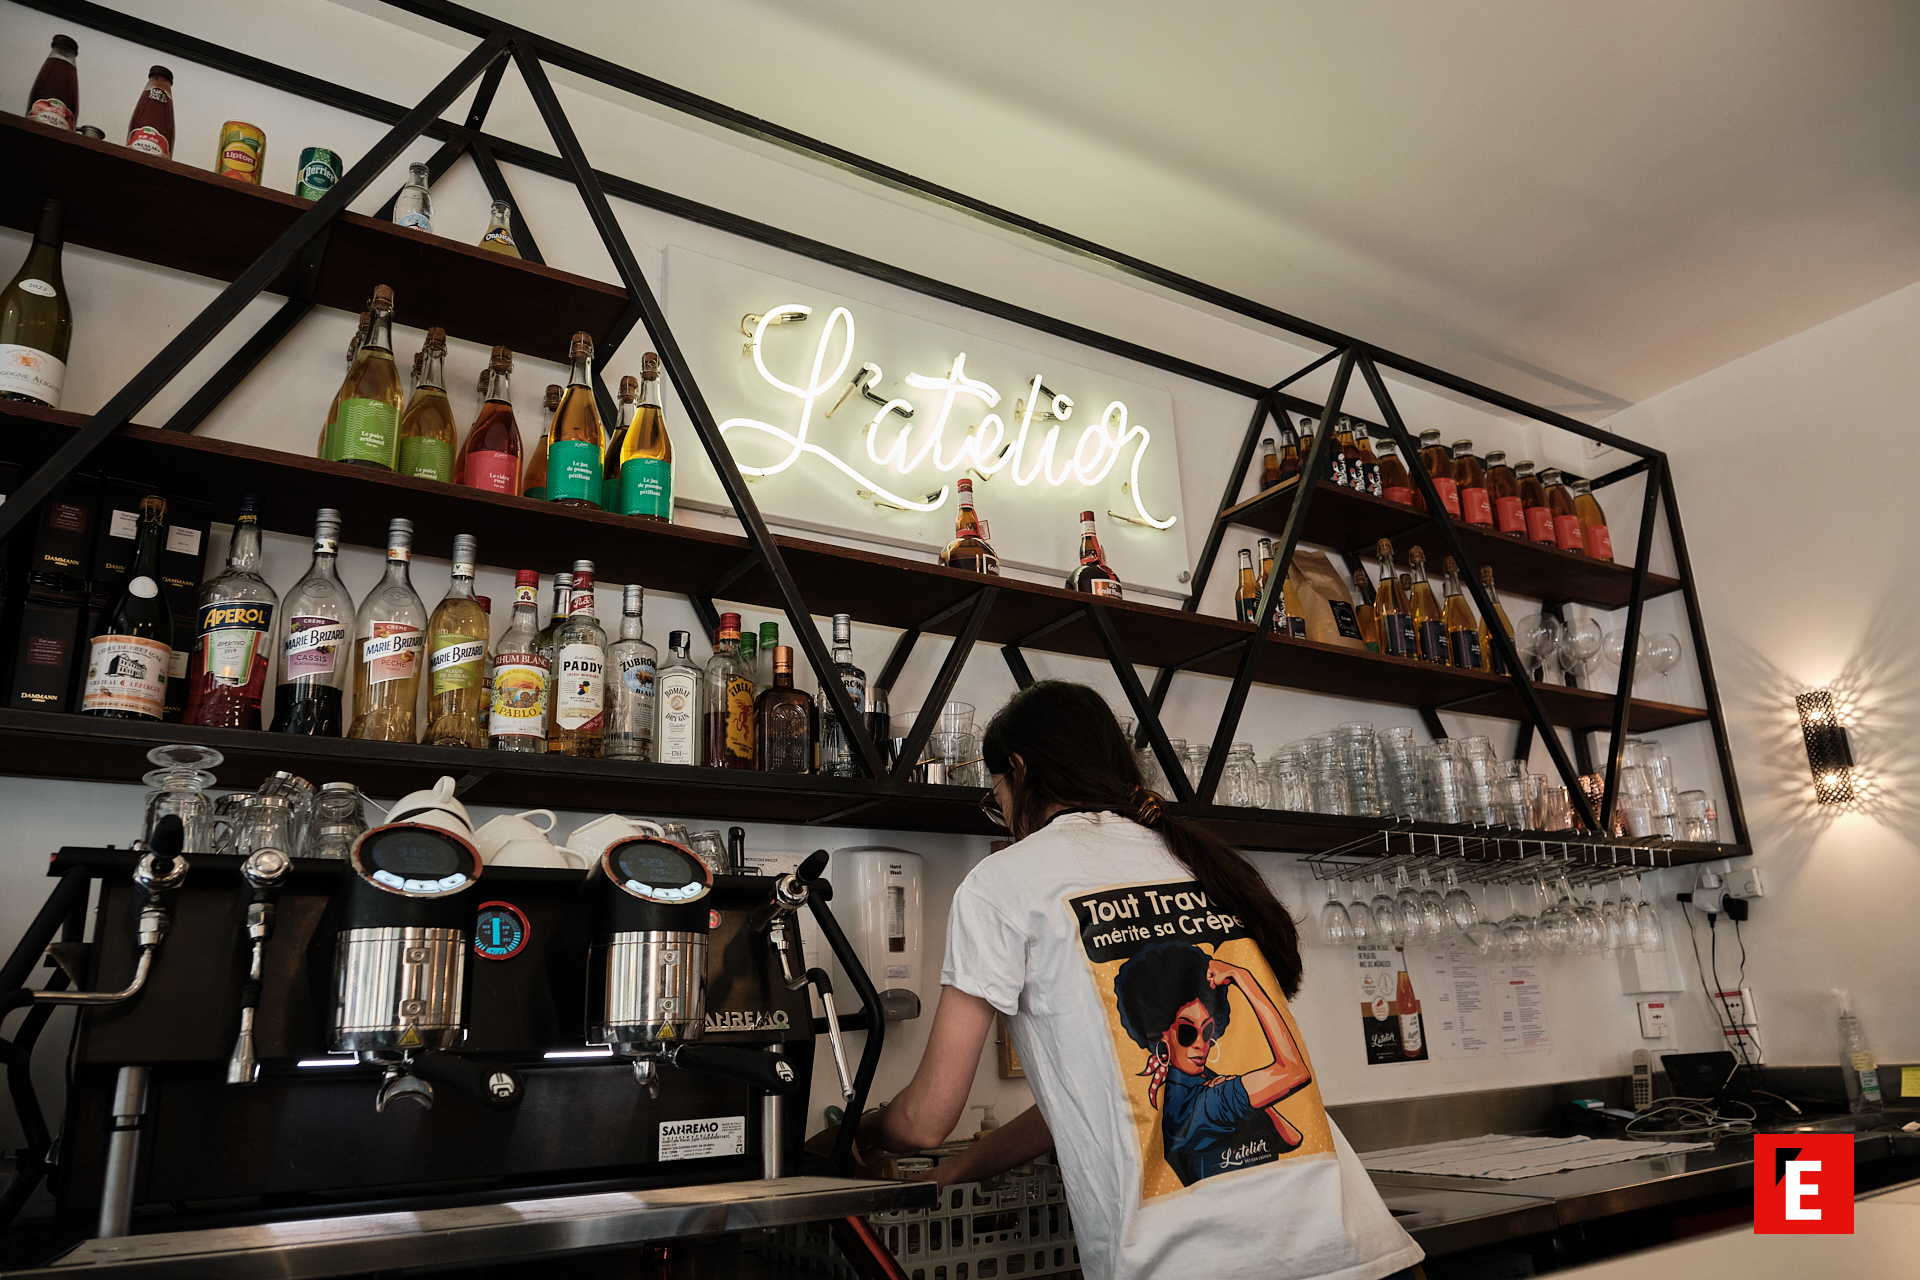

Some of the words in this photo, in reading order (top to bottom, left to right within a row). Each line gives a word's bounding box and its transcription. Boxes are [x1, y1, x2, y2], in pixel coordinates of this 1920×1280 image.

[225, 152, 254, 164] Lipton
[305, 166, 335, 182] Perrier
[203, 608, 265, 629] APEROL
[284, 635, 309, 652] MARIE
[310, 629, 345, 646] BRIZARD
[366, 641, 391, 656] MARIE
[392, 636, 423, 652] BRIZARD
[296, 654, 327, 662] CASSIS
[430, 651, 451, 669] MARIE
[452, 645, 483, 662] BRIZARD
[495, 655, 519, 665] RHUM
[521, 655, 547, 667] BLANC
[563, 661, 603, 674] PADDY
[20, 692, 58, 701] DAMMANN
[664, 687, 691, 698] BOMBAY
[499, 707, 537, 718] PABLO
[665, 712, 677, 722] DRY
[678, 712, 690, 721] GIN
[1082, 893, 1140, 926] Tout
[1144, 890, 1217, 916] Trav
[1093, 925, 1151, 949] mérite
[1154, 922, 1176, 937] sa
[705, 1010, 790, 1032] ANREMO
[662, 1122, 719, 1136] SANREMO
[1220, 1139, 1270, 1169] L'atelier
